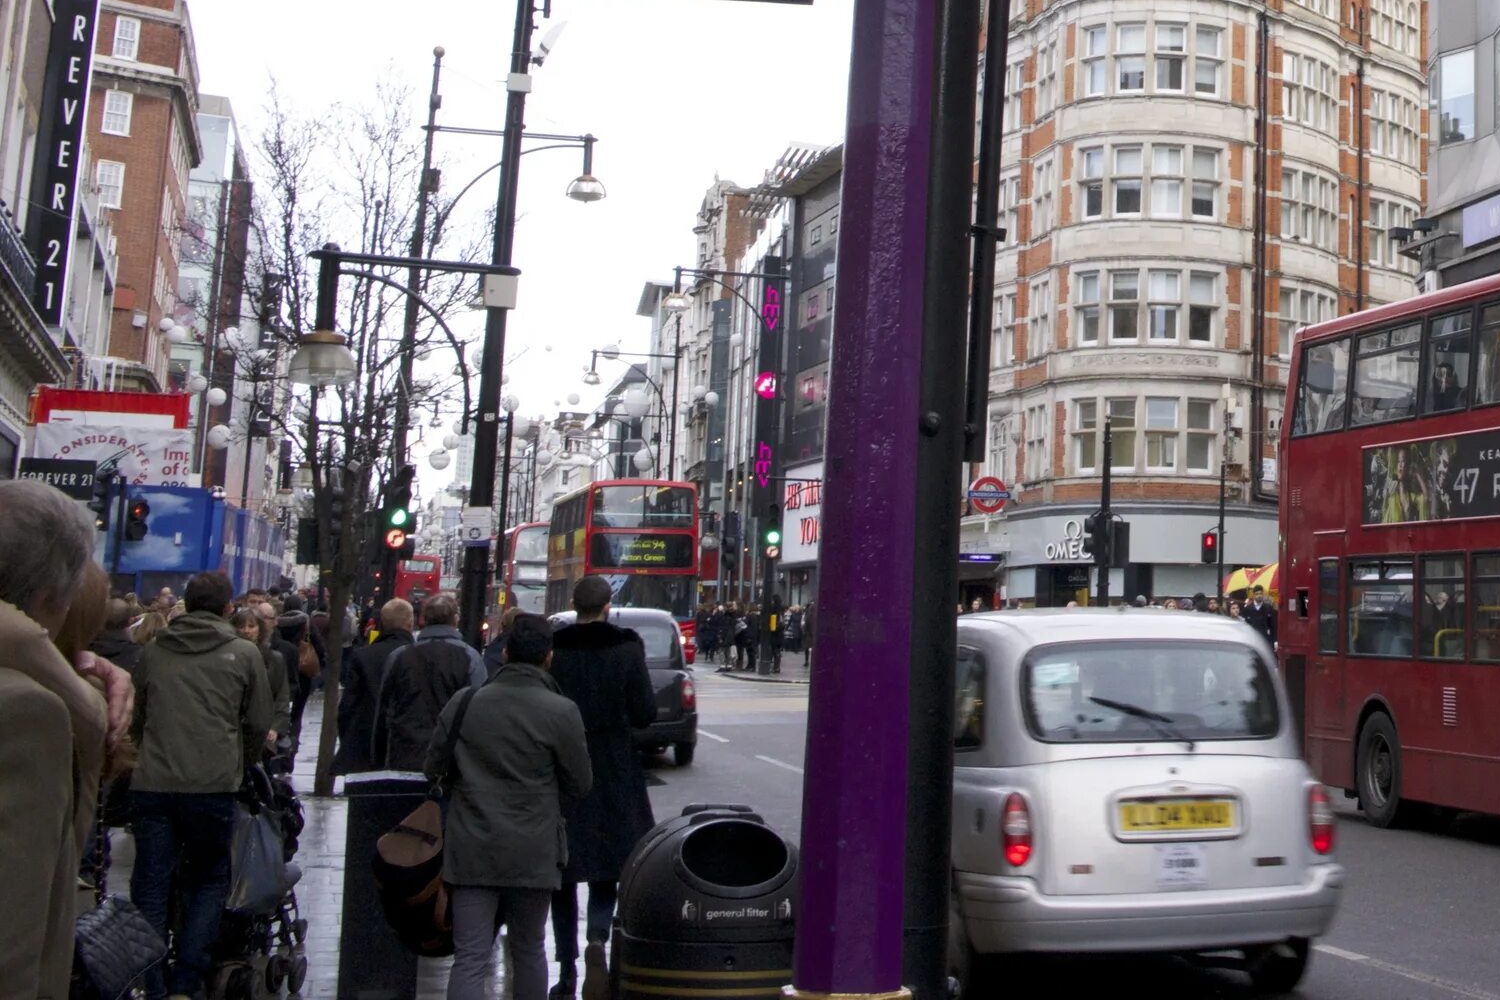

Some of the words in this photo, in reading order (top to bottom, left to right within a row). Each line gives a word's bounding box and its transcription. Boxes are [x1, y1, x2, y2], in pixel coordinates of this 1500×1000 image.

[762, 285, 780, 331] hmv
[755, 441, 772, 488] hmv
[1453, 468, 1479, 504] 47
[706, 908, 744, 920] general
